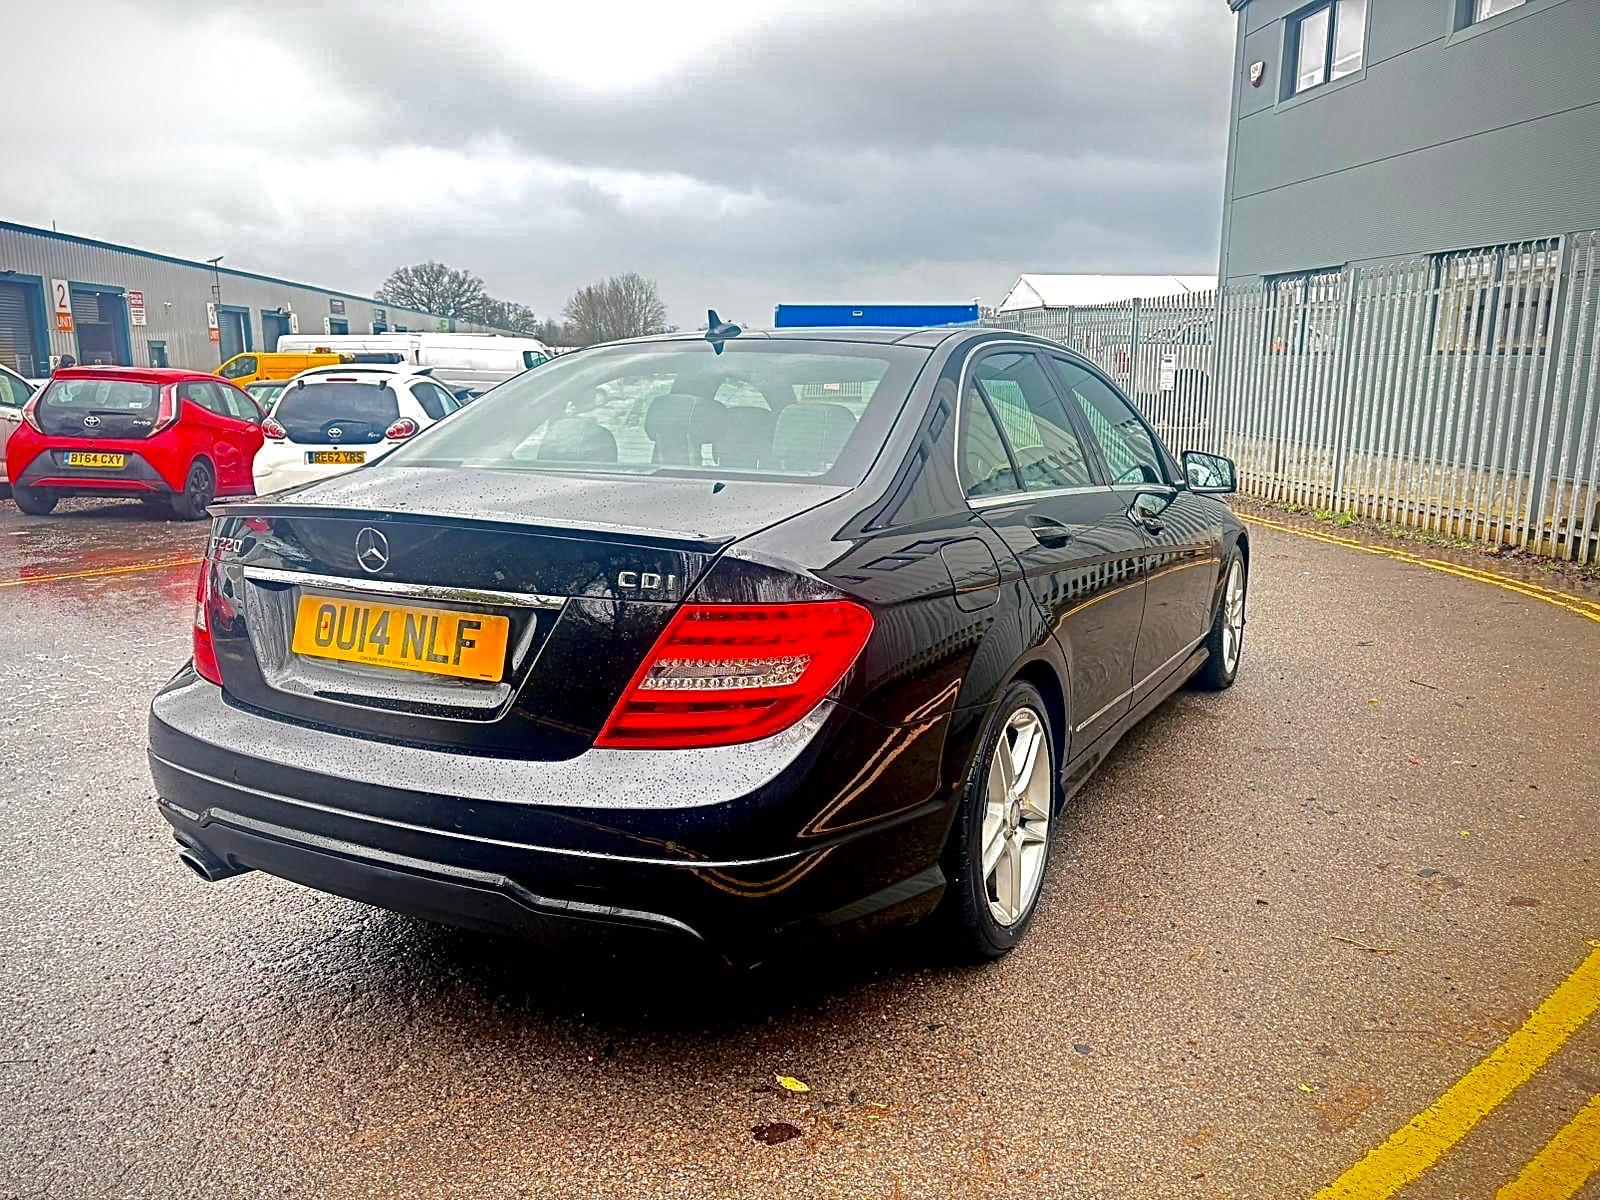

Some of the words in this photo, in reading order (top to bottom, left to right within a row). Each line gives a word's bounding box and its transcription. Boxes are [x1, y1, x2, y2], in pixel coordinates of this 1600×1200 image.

[57, 284, 67, 308] 2
[56, 314, 73, 328] UNIT
[71, 453, 98, 464] BT64
[101, 454, 122, 465] CXY
[314, 451, 341, 463] RE62
[343, 451, 365, 463] YRS
[618, 571, 676, 590] CDI
[314, 603, 390, 655] OU14
[400, 613, 482, 666] NLF
